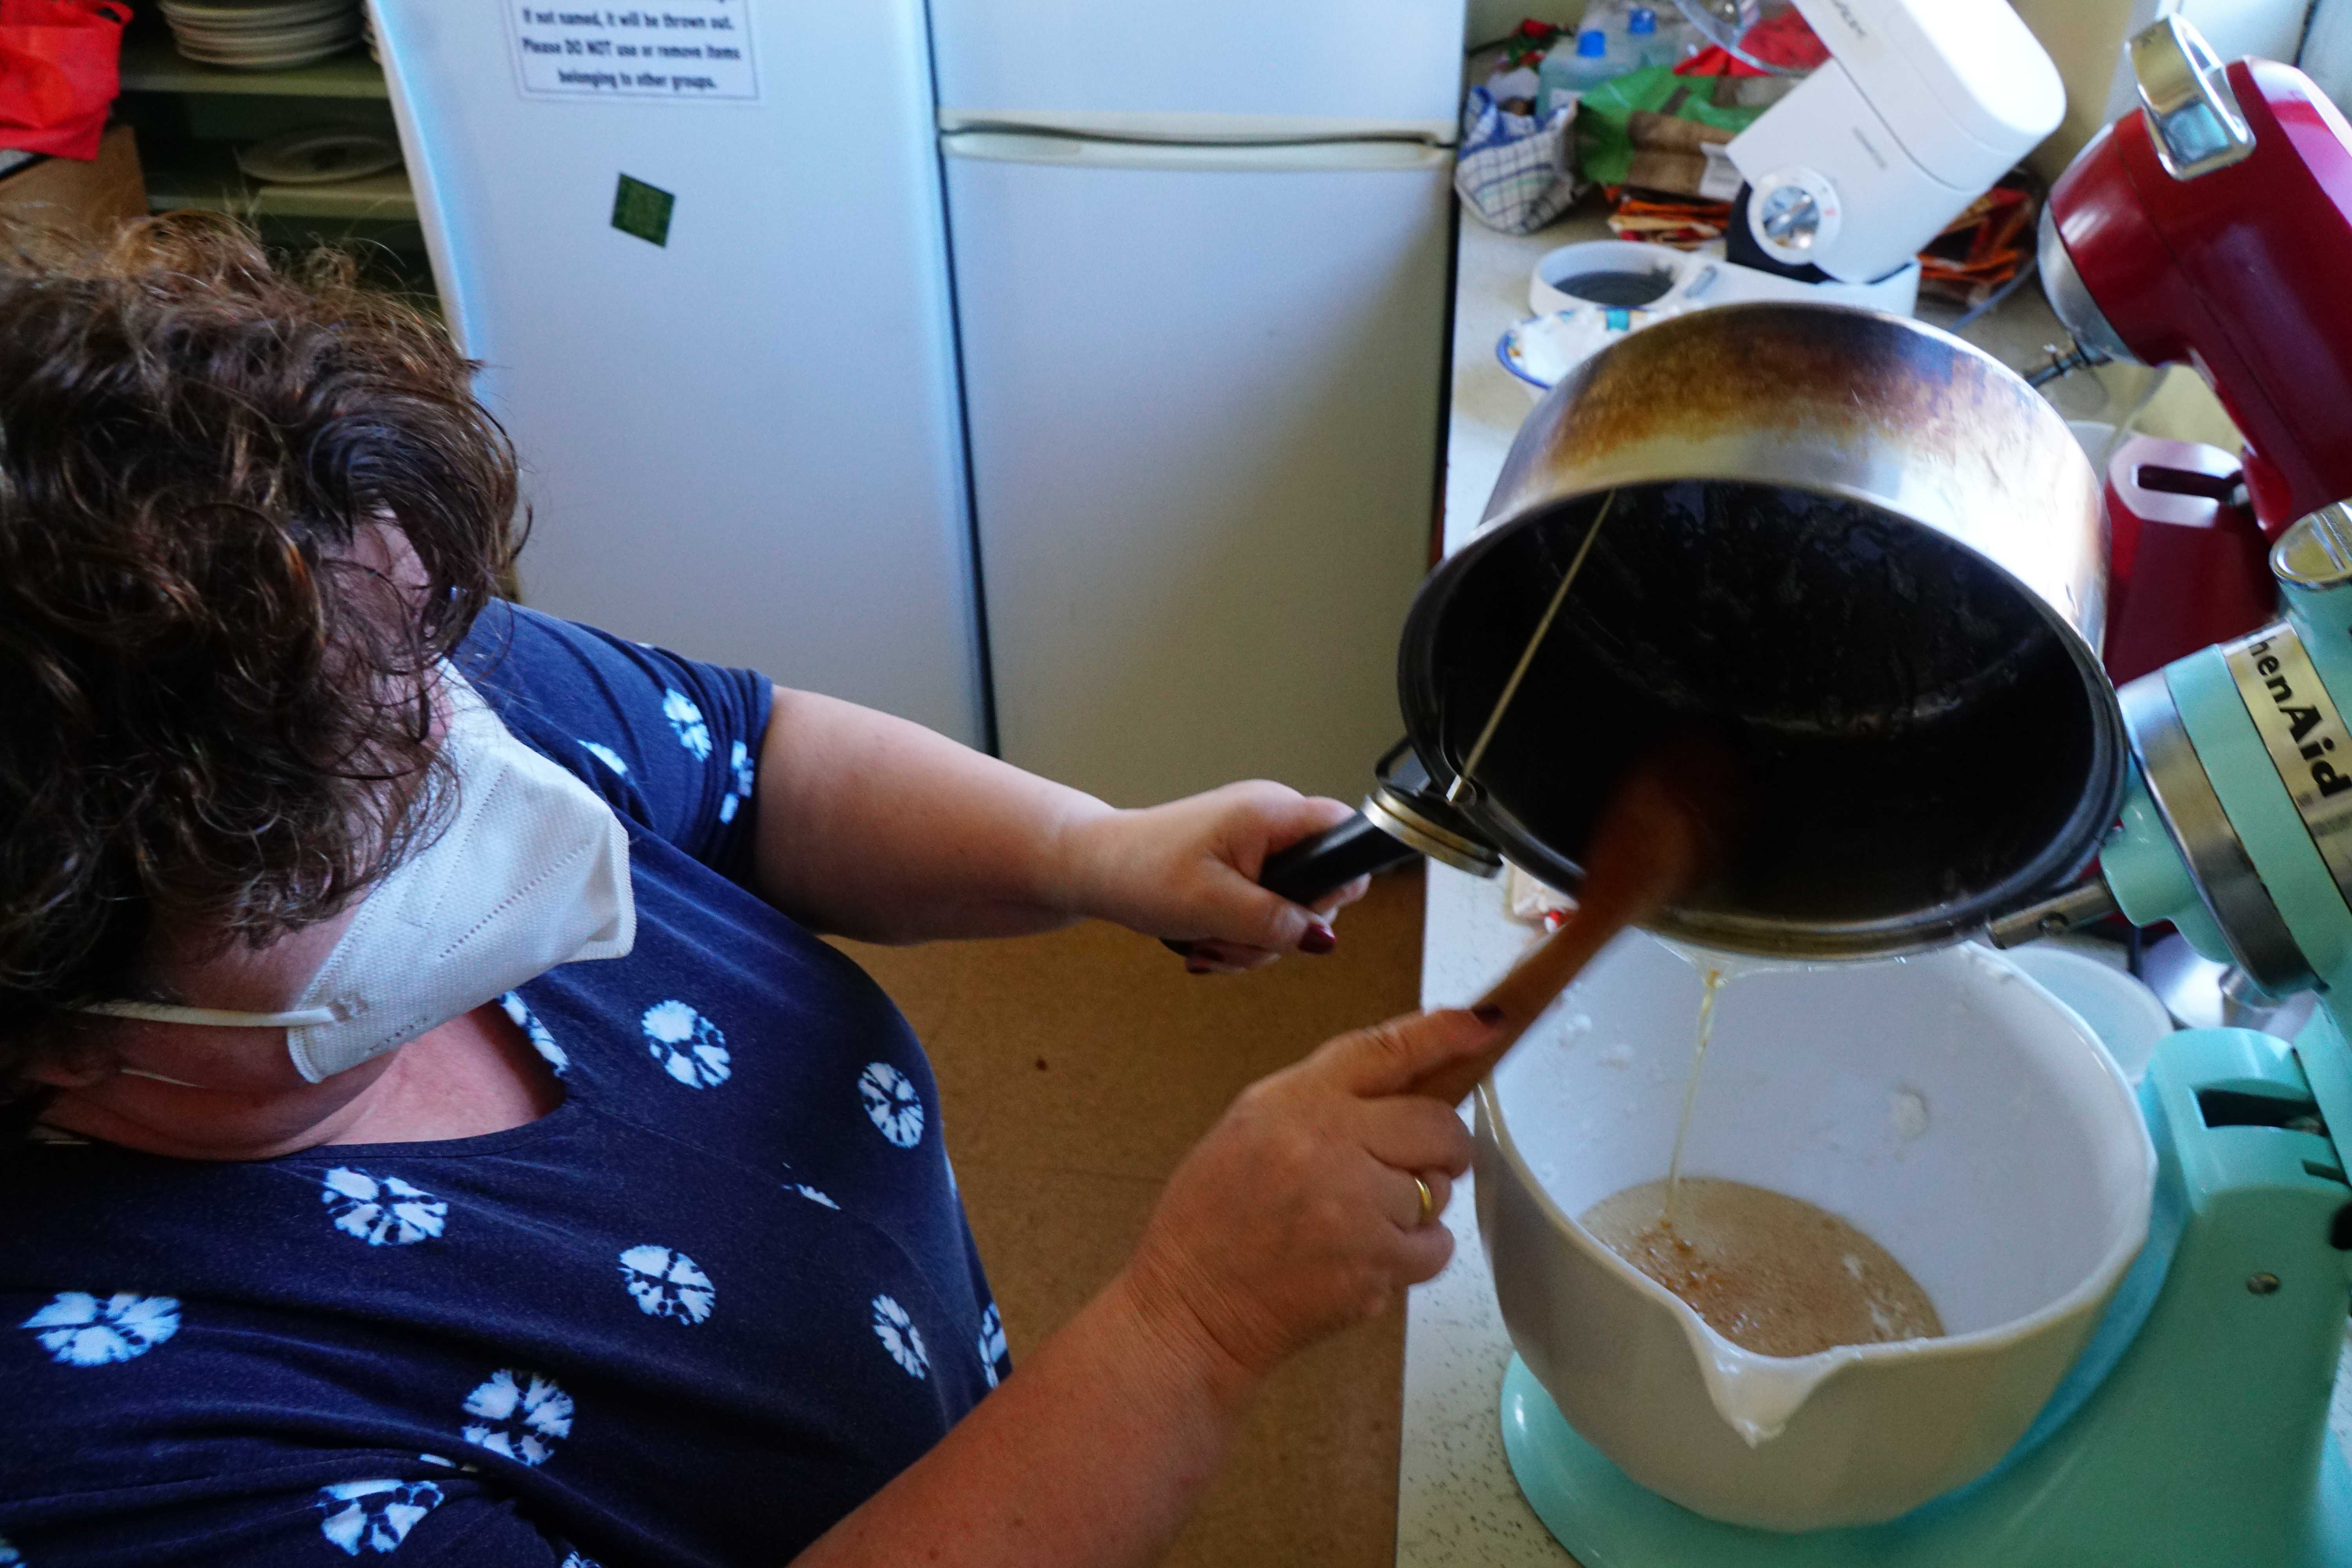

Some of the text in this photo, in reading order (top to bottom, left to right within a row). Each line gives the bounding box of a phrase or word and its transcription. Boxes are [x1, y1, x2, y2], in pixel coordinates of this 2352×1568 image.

[522, 8, 734, 29] If not named, it will be thrown out.
[522, 38, 740, 59] Please DO NOT use or remove items
[558, 68, 716, 91] belonging to other groups.
